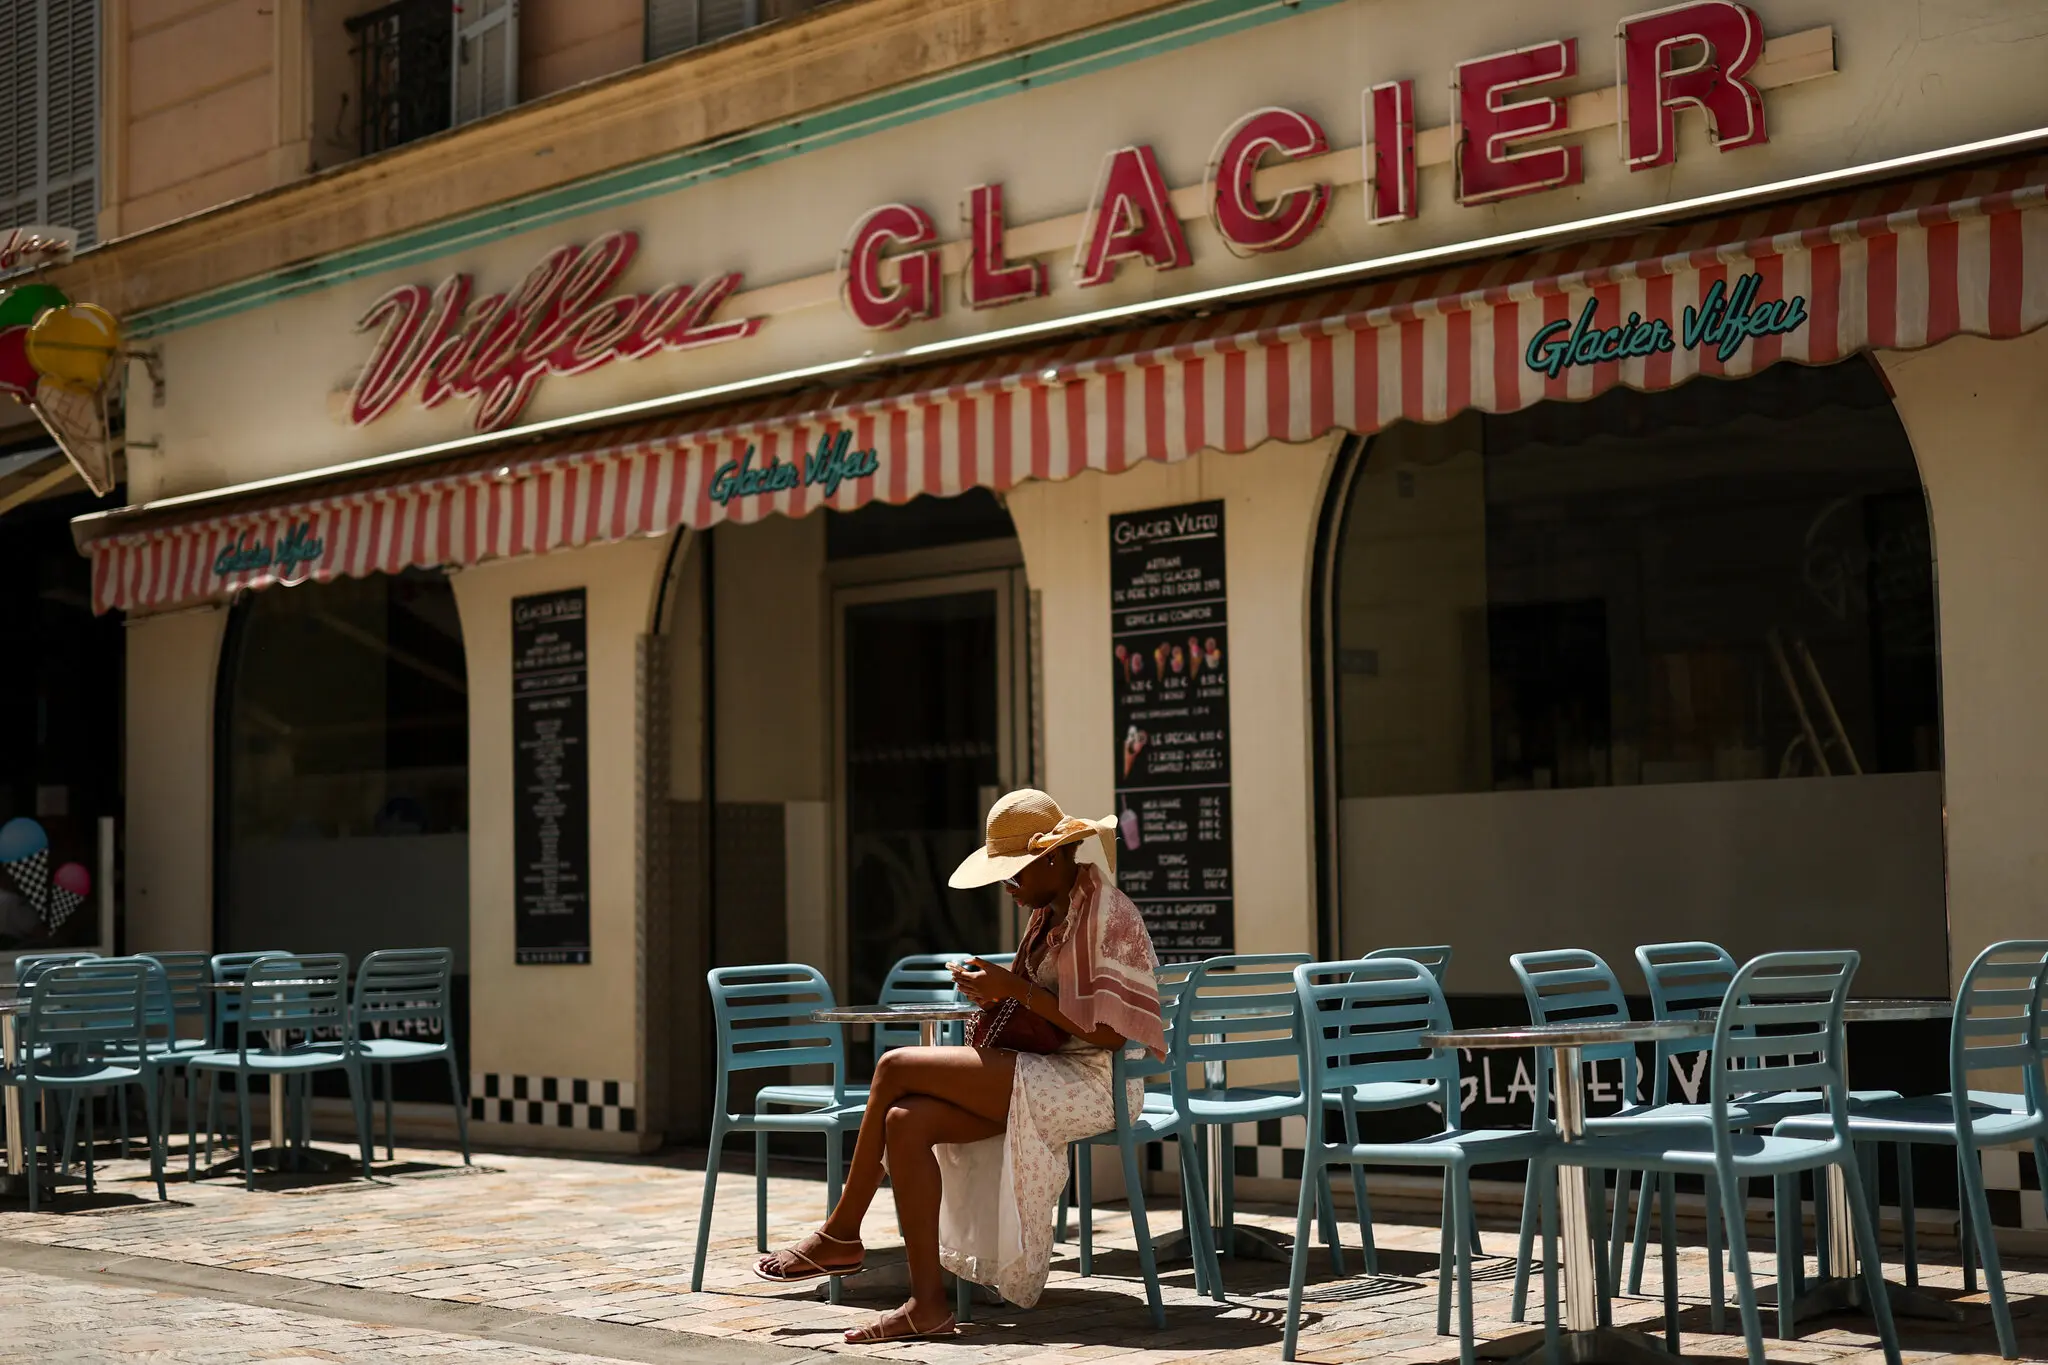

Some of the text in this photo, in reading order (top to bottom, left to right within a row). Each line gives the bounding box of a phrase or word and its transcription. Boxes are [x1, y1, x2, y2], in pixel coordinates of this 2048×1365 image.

[838, 0, 1770, 332] GLACIER
[1525, 273, 1808, 380] Glacier Vilfeu
[709, 443, 799, 507] Glacier
